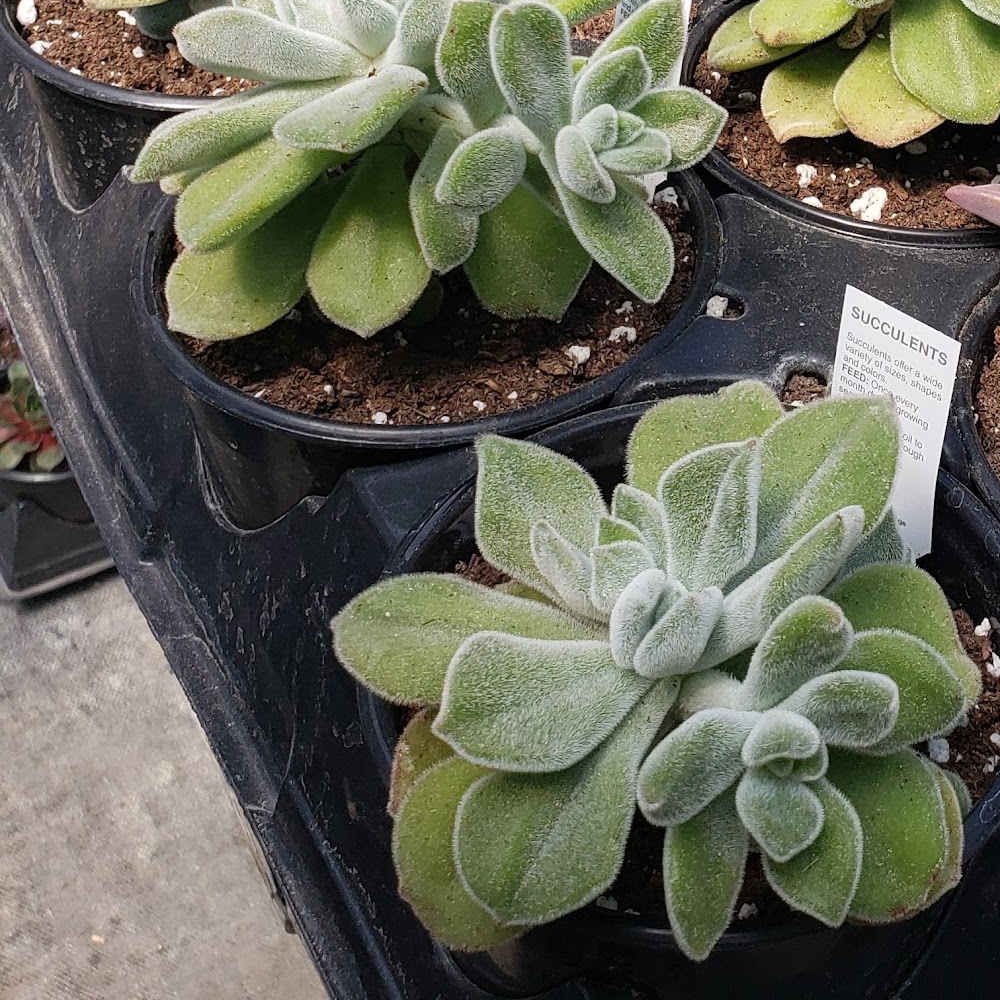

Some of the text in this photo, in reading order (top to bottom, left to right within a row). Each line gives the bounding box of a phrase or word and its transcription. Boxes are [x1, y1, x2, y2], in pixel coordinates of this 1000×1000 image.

[851, 306, 948, 366] SUCCULENTS
[843, 354, 888, 384] and colors.
[845, 343, 942, 402] variety of sizes, shapes
[846, 331, 943, 390] Succulents offer a wide
[840, 375, 866, 395] month
[842, 363, 869, 385] FEED:
[895, 395, 919, 413] every
[896, 406, 929, 431] growing
[901, 433, 923, 449] oil to
